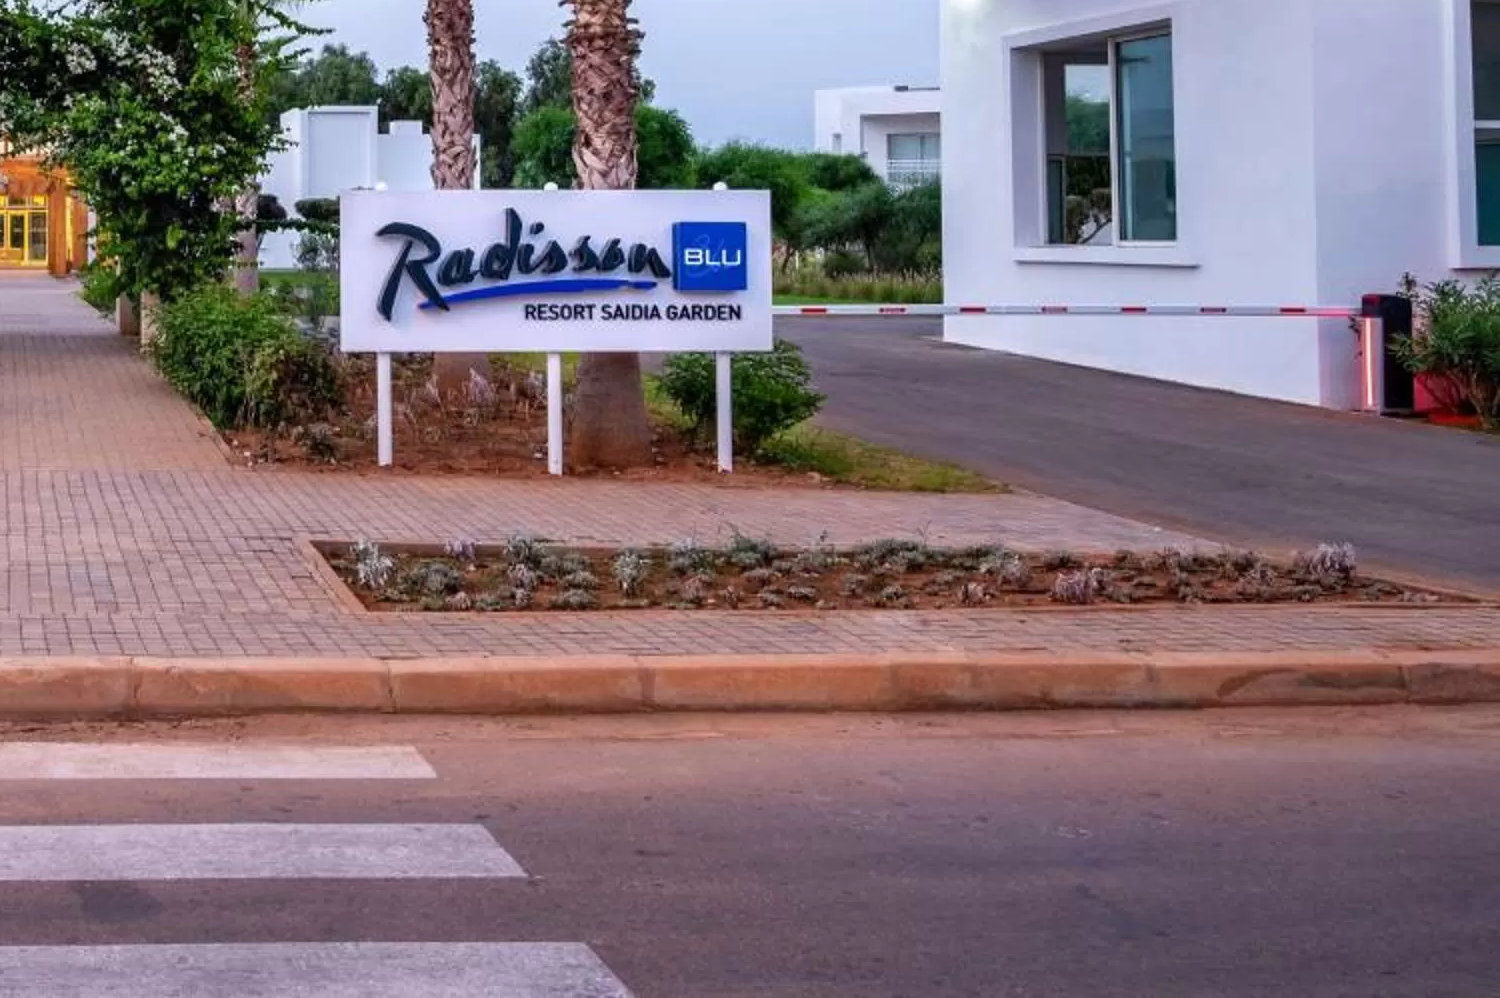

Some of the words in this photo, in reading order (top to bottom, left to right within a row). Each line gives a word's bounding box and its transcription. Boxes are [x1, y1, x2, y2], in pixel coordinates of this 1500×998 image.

[375, 207, 672, 322] Radisson
[684, 248, 741, 266] BLU
[524, 303, 596, 321] RESORT
[600, 303, 662, 321] SAIDIA
[665, 303, 742, 321] GARDEN
